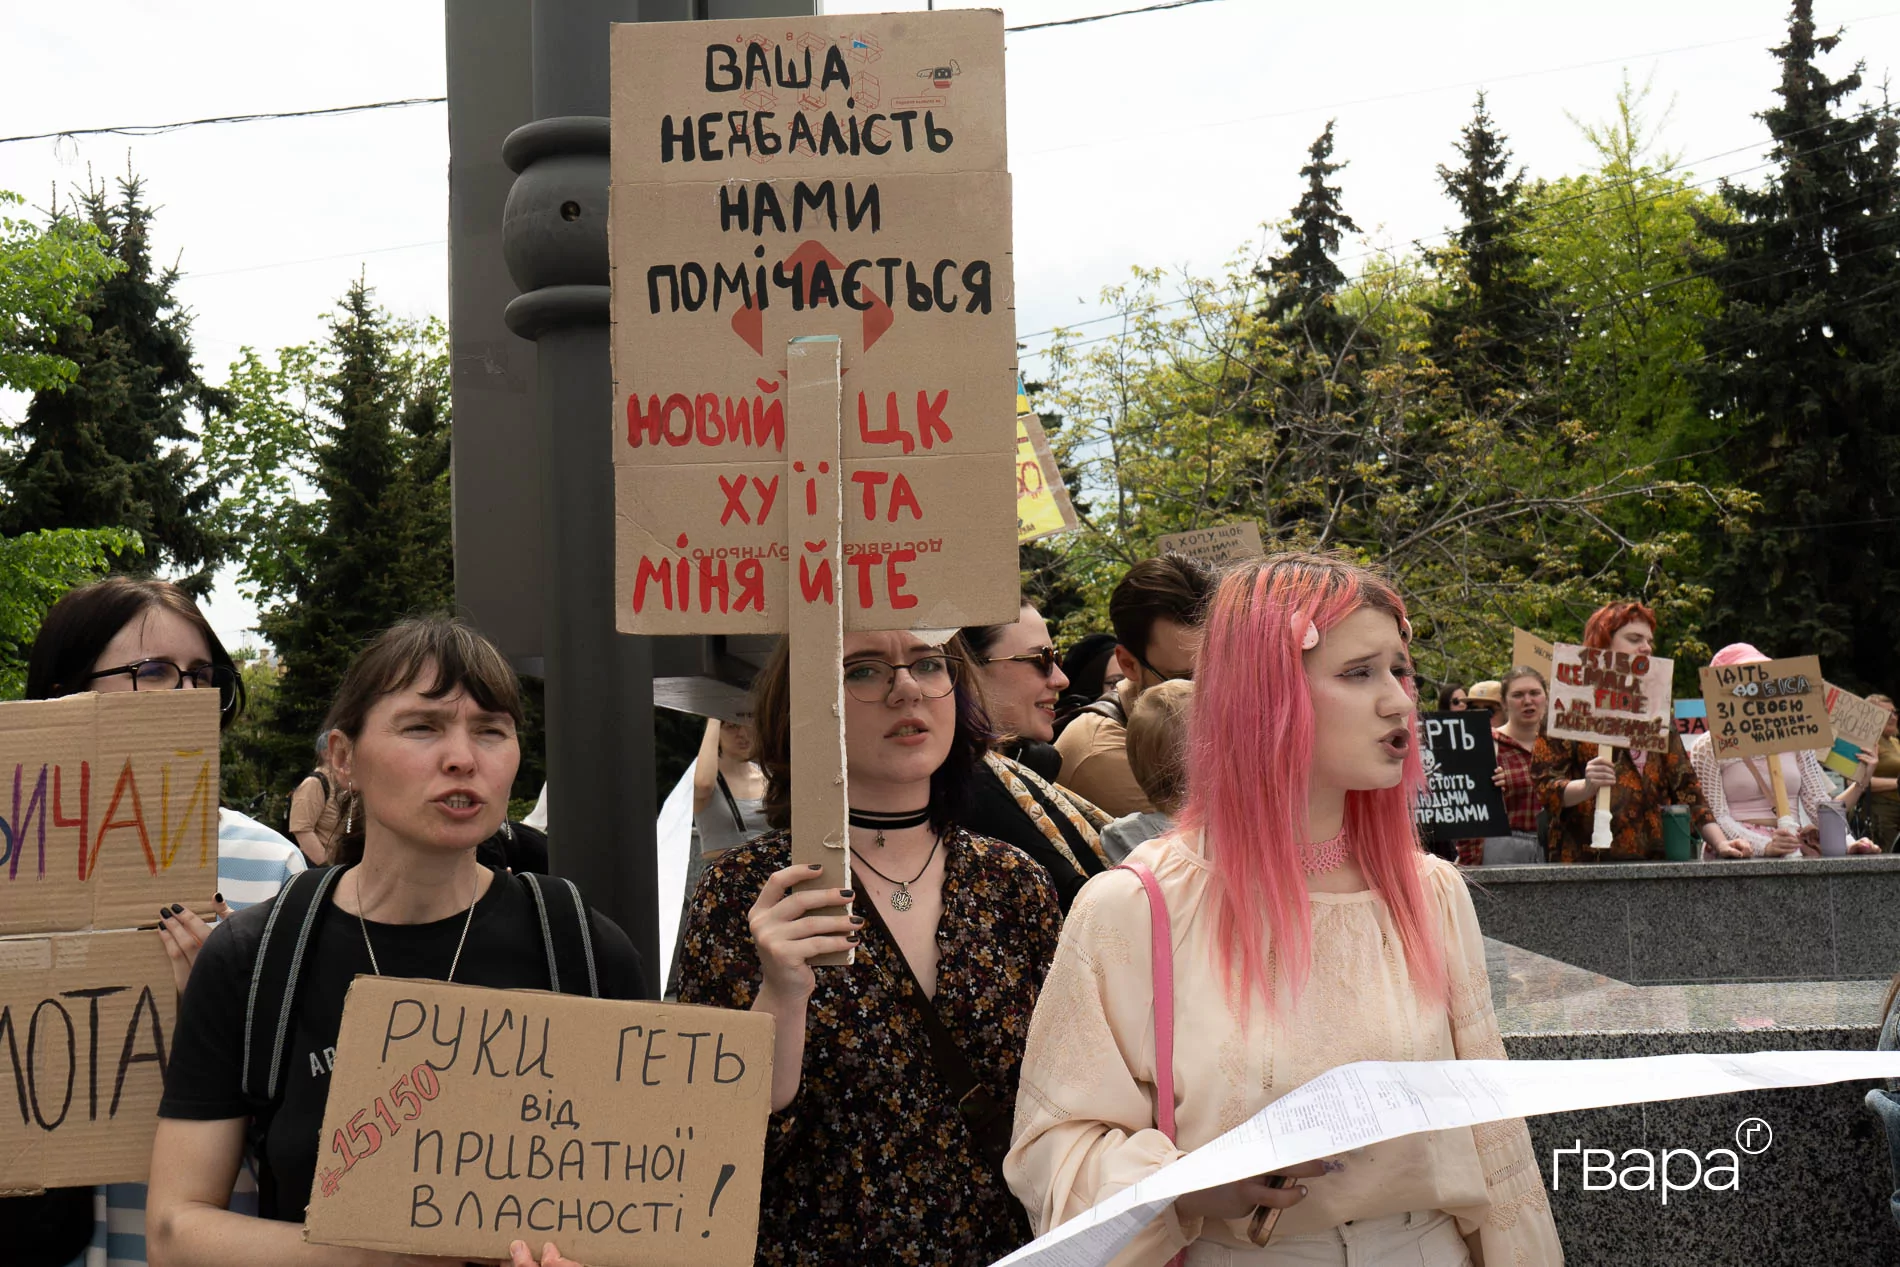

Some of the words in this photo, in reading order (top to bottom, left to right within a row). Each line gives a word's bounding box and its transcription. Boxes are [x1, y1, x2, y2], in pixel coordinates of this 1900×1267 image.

[705, 42, 850, 93] ВАША
[660, 96, 954, 163] НЕДБАЛІСТЬ
[719, 179, 881, 236] НАМИ
[647, 244, 992, 315] ПОМІЧАЄТЬСЯ
[626, 377, 784, 453] НОВИЙ
[858, 388, 953, 454] ЦК
[692, 542, 789, 562] бутнього
[0, 749, 210, 881] ИЧАЙ
[382, 999, 554, 1078] РУКИ
[413, 1126, 693, 1184] ПРИВАТНОЇ
